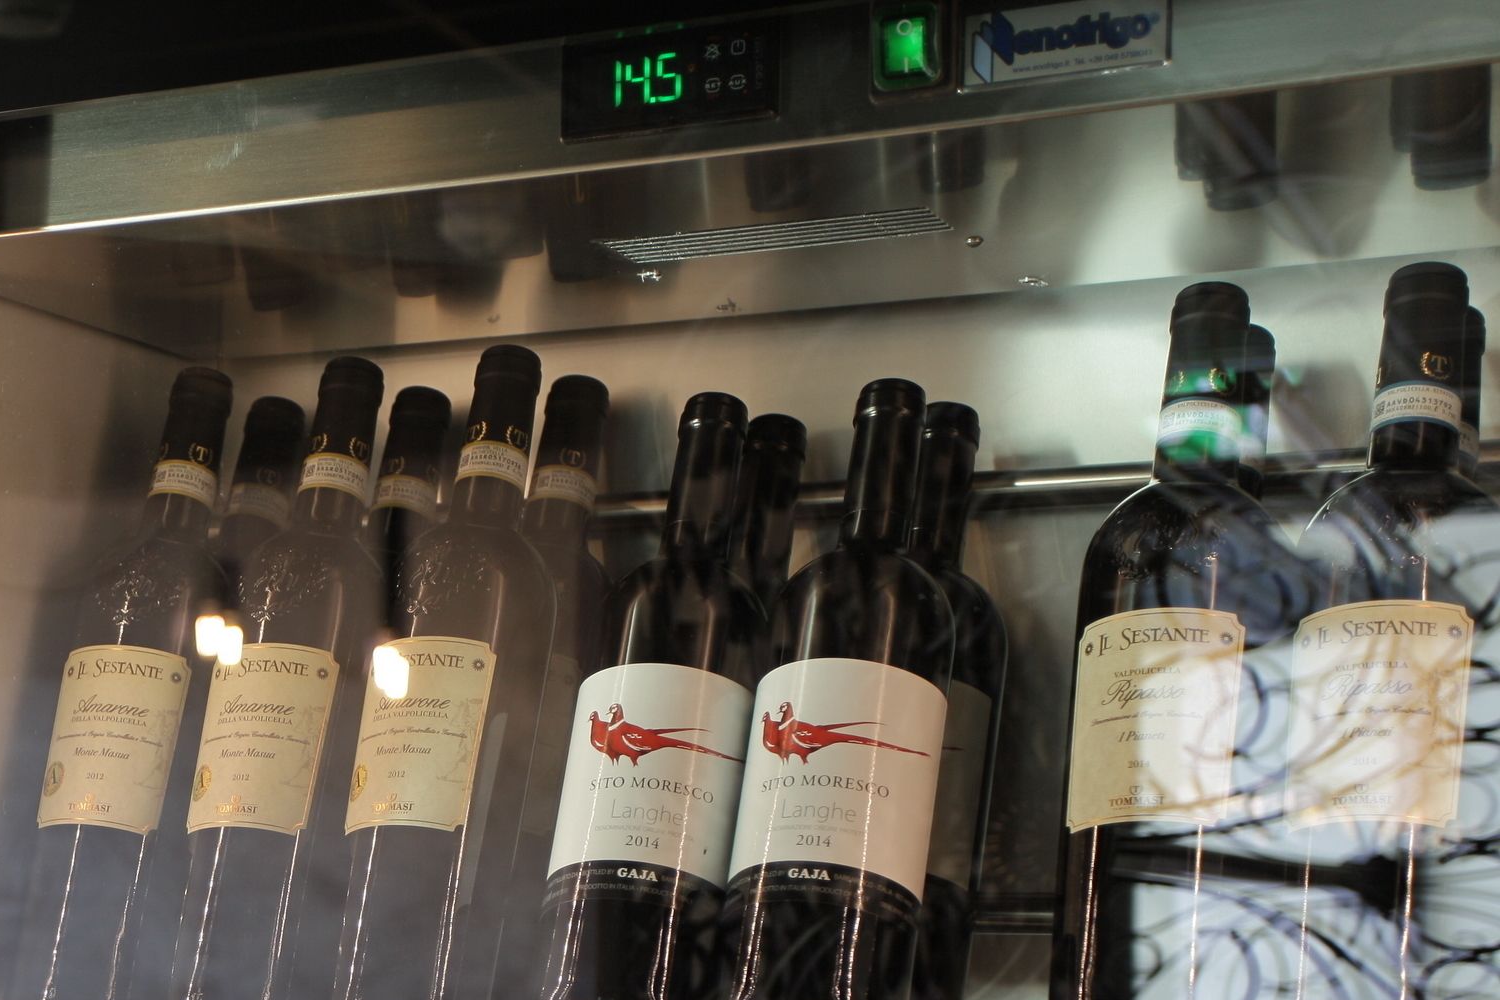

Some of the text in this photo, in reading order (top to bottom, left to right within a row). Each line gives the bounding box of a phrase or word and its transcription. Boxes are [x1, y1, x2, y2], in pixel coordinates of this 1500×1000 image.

[615, 52, 682, 107] 14.5
[1098, 627, 1211, 657] IL SESTANTE
[1317, 620, 1437, 650] IL SESTANTE
[77, 658, 164, 681] IL SESTANTE
[238, 658, 309, 678] SESTANTE
[1114, 666, 1181, 679] VALPOLICELLA
[1335, 660, 1408, 672] VALPOLICELLA
[1101, 679, 1186, 710] Ripasso
[1323, 673, 1413, 704] Ripasso
[73, 694, 151, 718] Amarone
[220, 694, 295, 716] Amarone
[71, 715, 147, 727] DELLA VALPOLICELLA
[217, 715, 293, 725] DELLA VALPOLICELLA
[373, 710, 449, 722] DELLA VALPOLICELLA
[73, 747, 131, 760] Monte Masua
[219, 747, 276, 760] Monte Masua
[375, 744, 432, 756] Monte Masua
[86, 771, 105, 780] 2012
[388, 770, 406, 779] 2012
[589, 777, 715, 804] SITO MORESCO
[761, 775, 890, 798] SITO MORESCO
[611, 799, 685, 826] Langhe
[781, 799, 857, 824] Langhe
[625, 835, 660, 849] 2014
[796, 834, 832, 848] 2014
[617, 867, 658, 882] GAJA
[788, 868, 831, 881] GAJA
